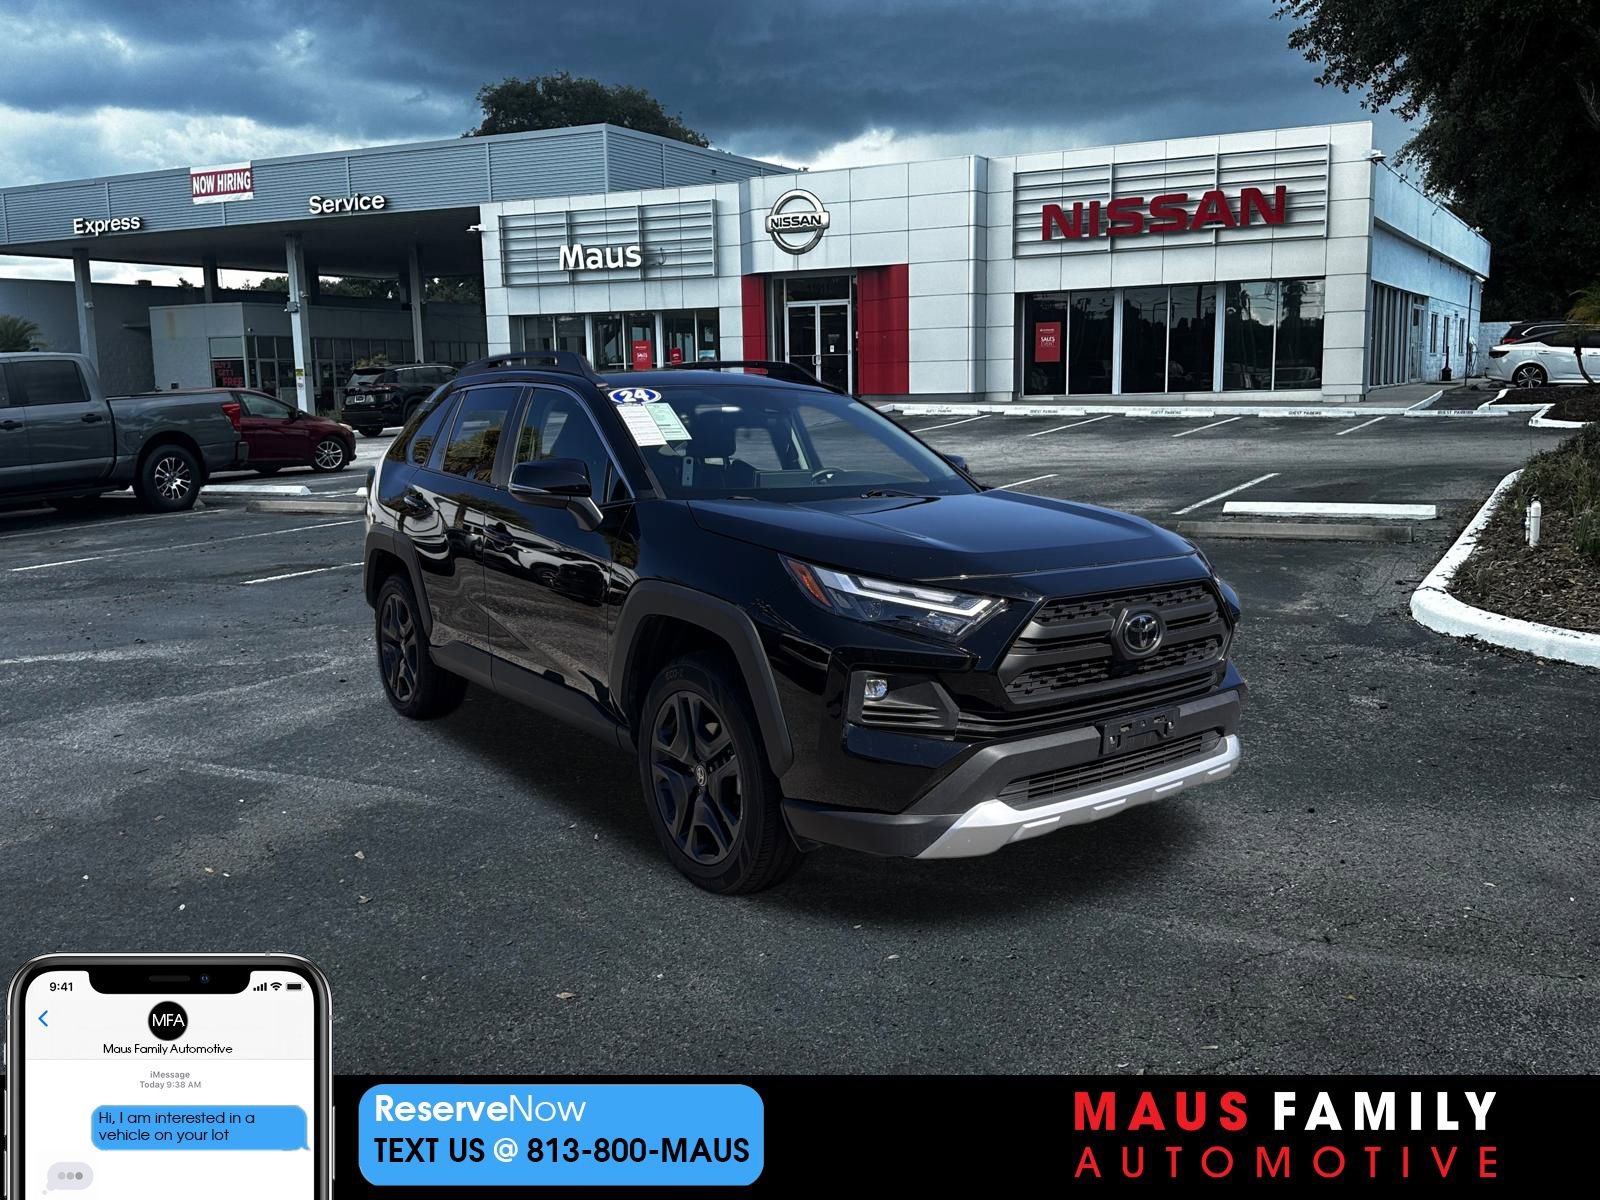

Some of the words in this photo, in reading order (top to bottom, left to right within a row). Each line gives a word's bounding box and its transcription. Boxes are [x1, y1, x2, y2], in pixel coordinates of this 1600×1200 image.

[192, 175, 216, 195] NOW
[217, 170, 251, 193] HIRING
[308, 193, 386, 215] Service
[1041, 185, 1287, 242] NISSAN
[73, 216, 141, 236] Express
[770, 214, 822, 229] NISSAN
[559, 242, 642, 271] Maus
[619, 389, 650, 402] 24
